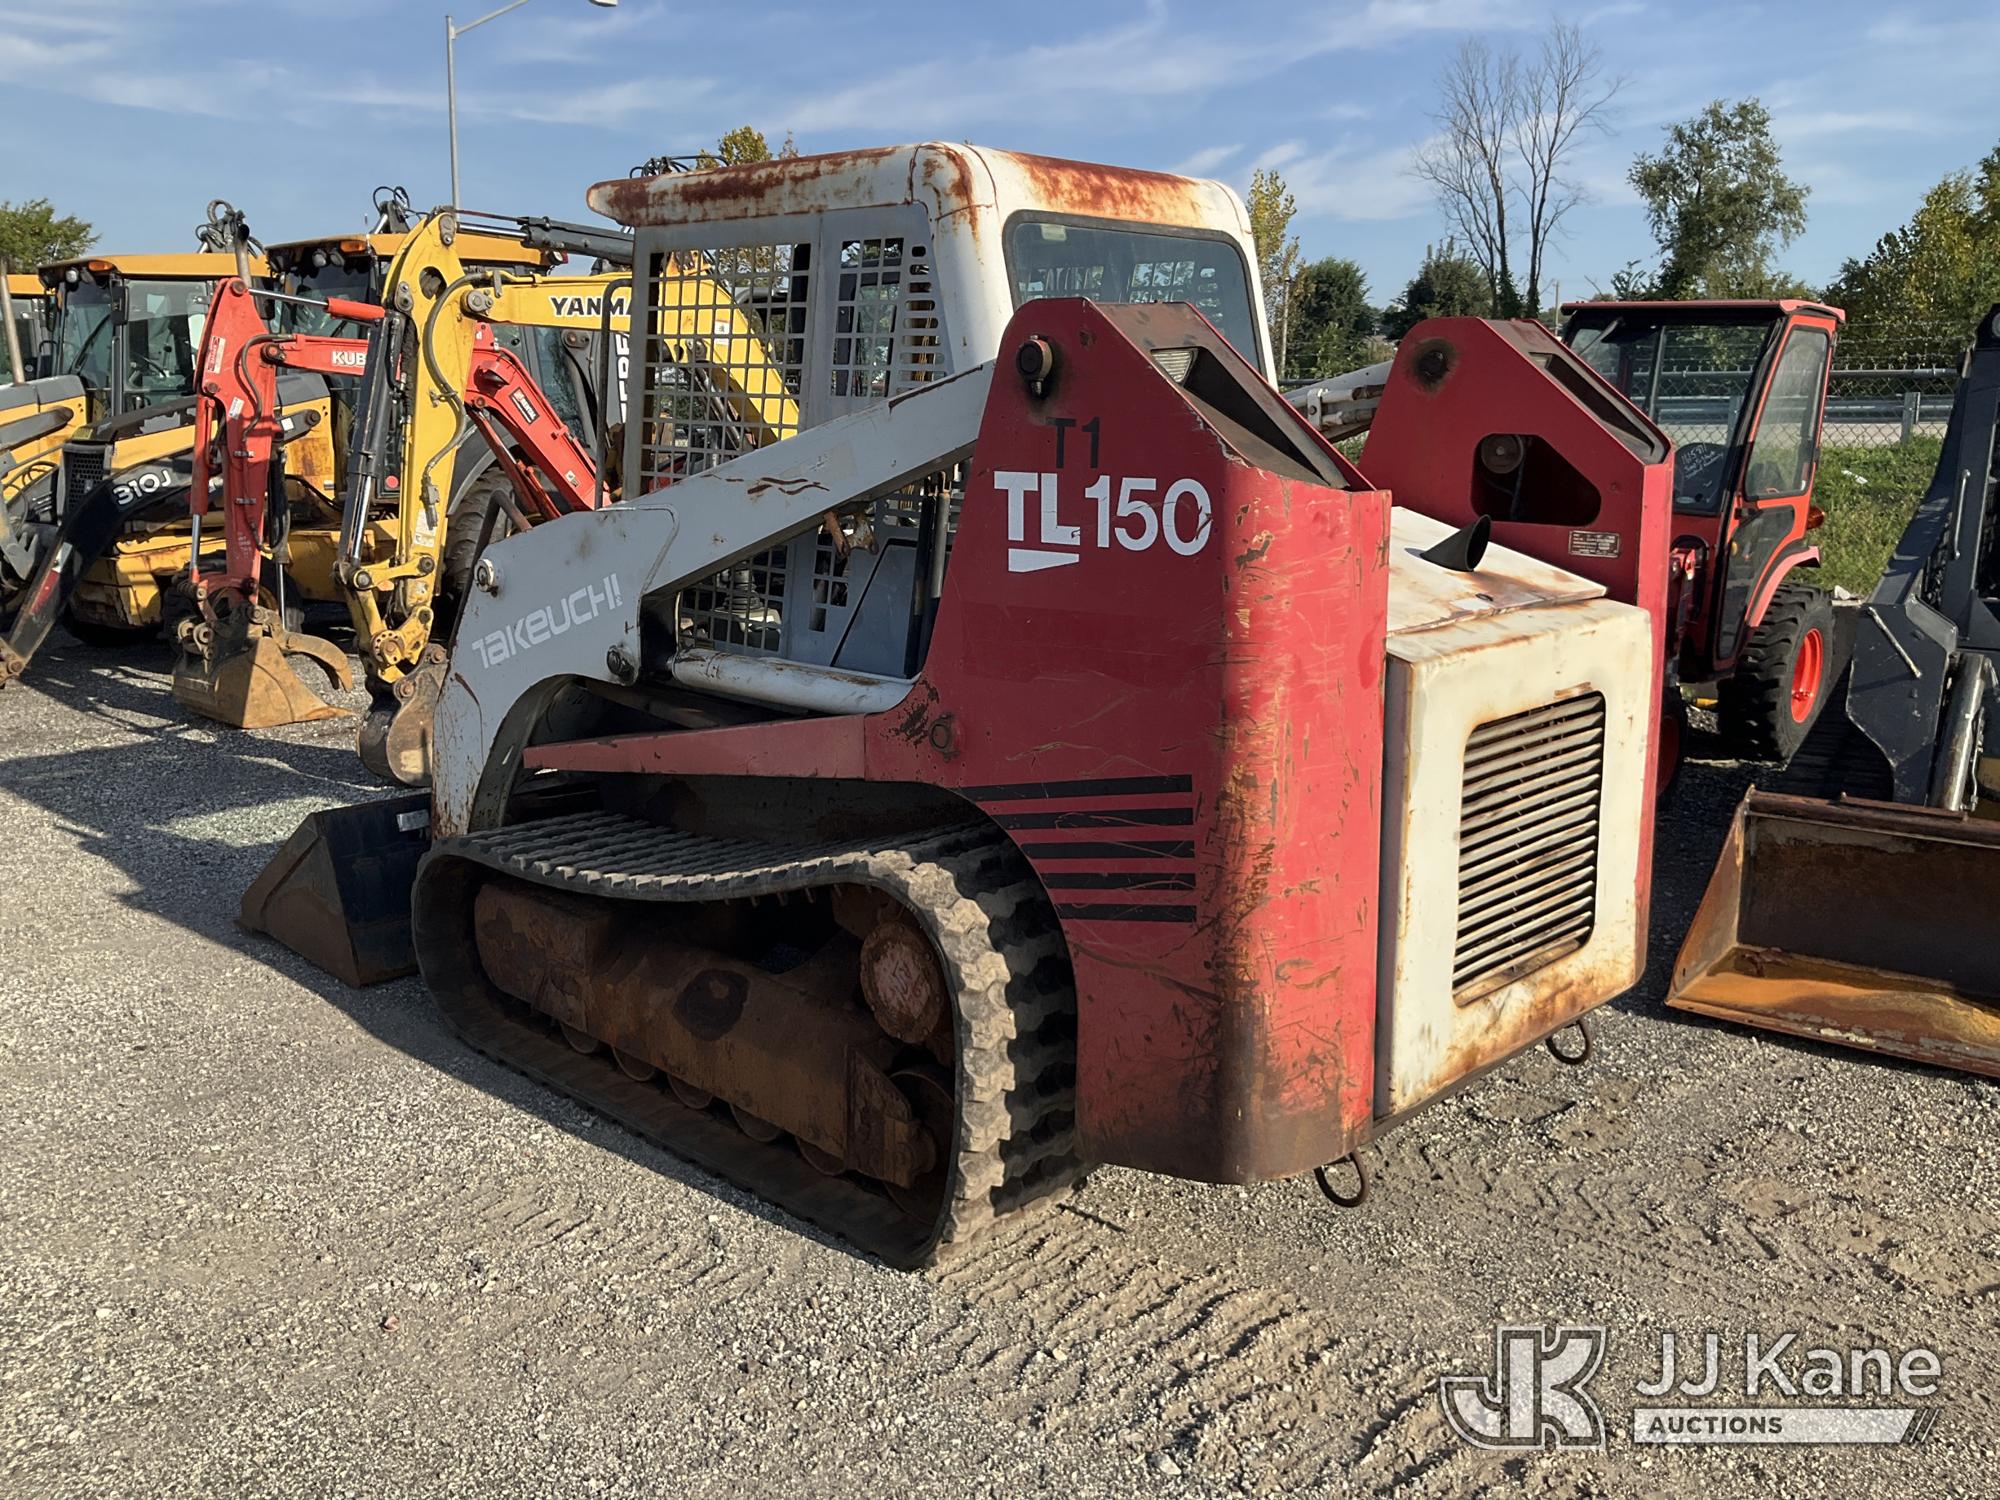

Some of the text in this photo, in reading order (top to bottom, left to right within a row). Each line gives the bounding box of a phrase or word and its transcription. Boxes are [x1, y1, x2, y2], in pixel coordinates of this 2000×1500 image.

[1046, 416, 1100, 469] T1
[113, 469, 172, 505] 310J
[994, 470, 1213, 557] TL150
